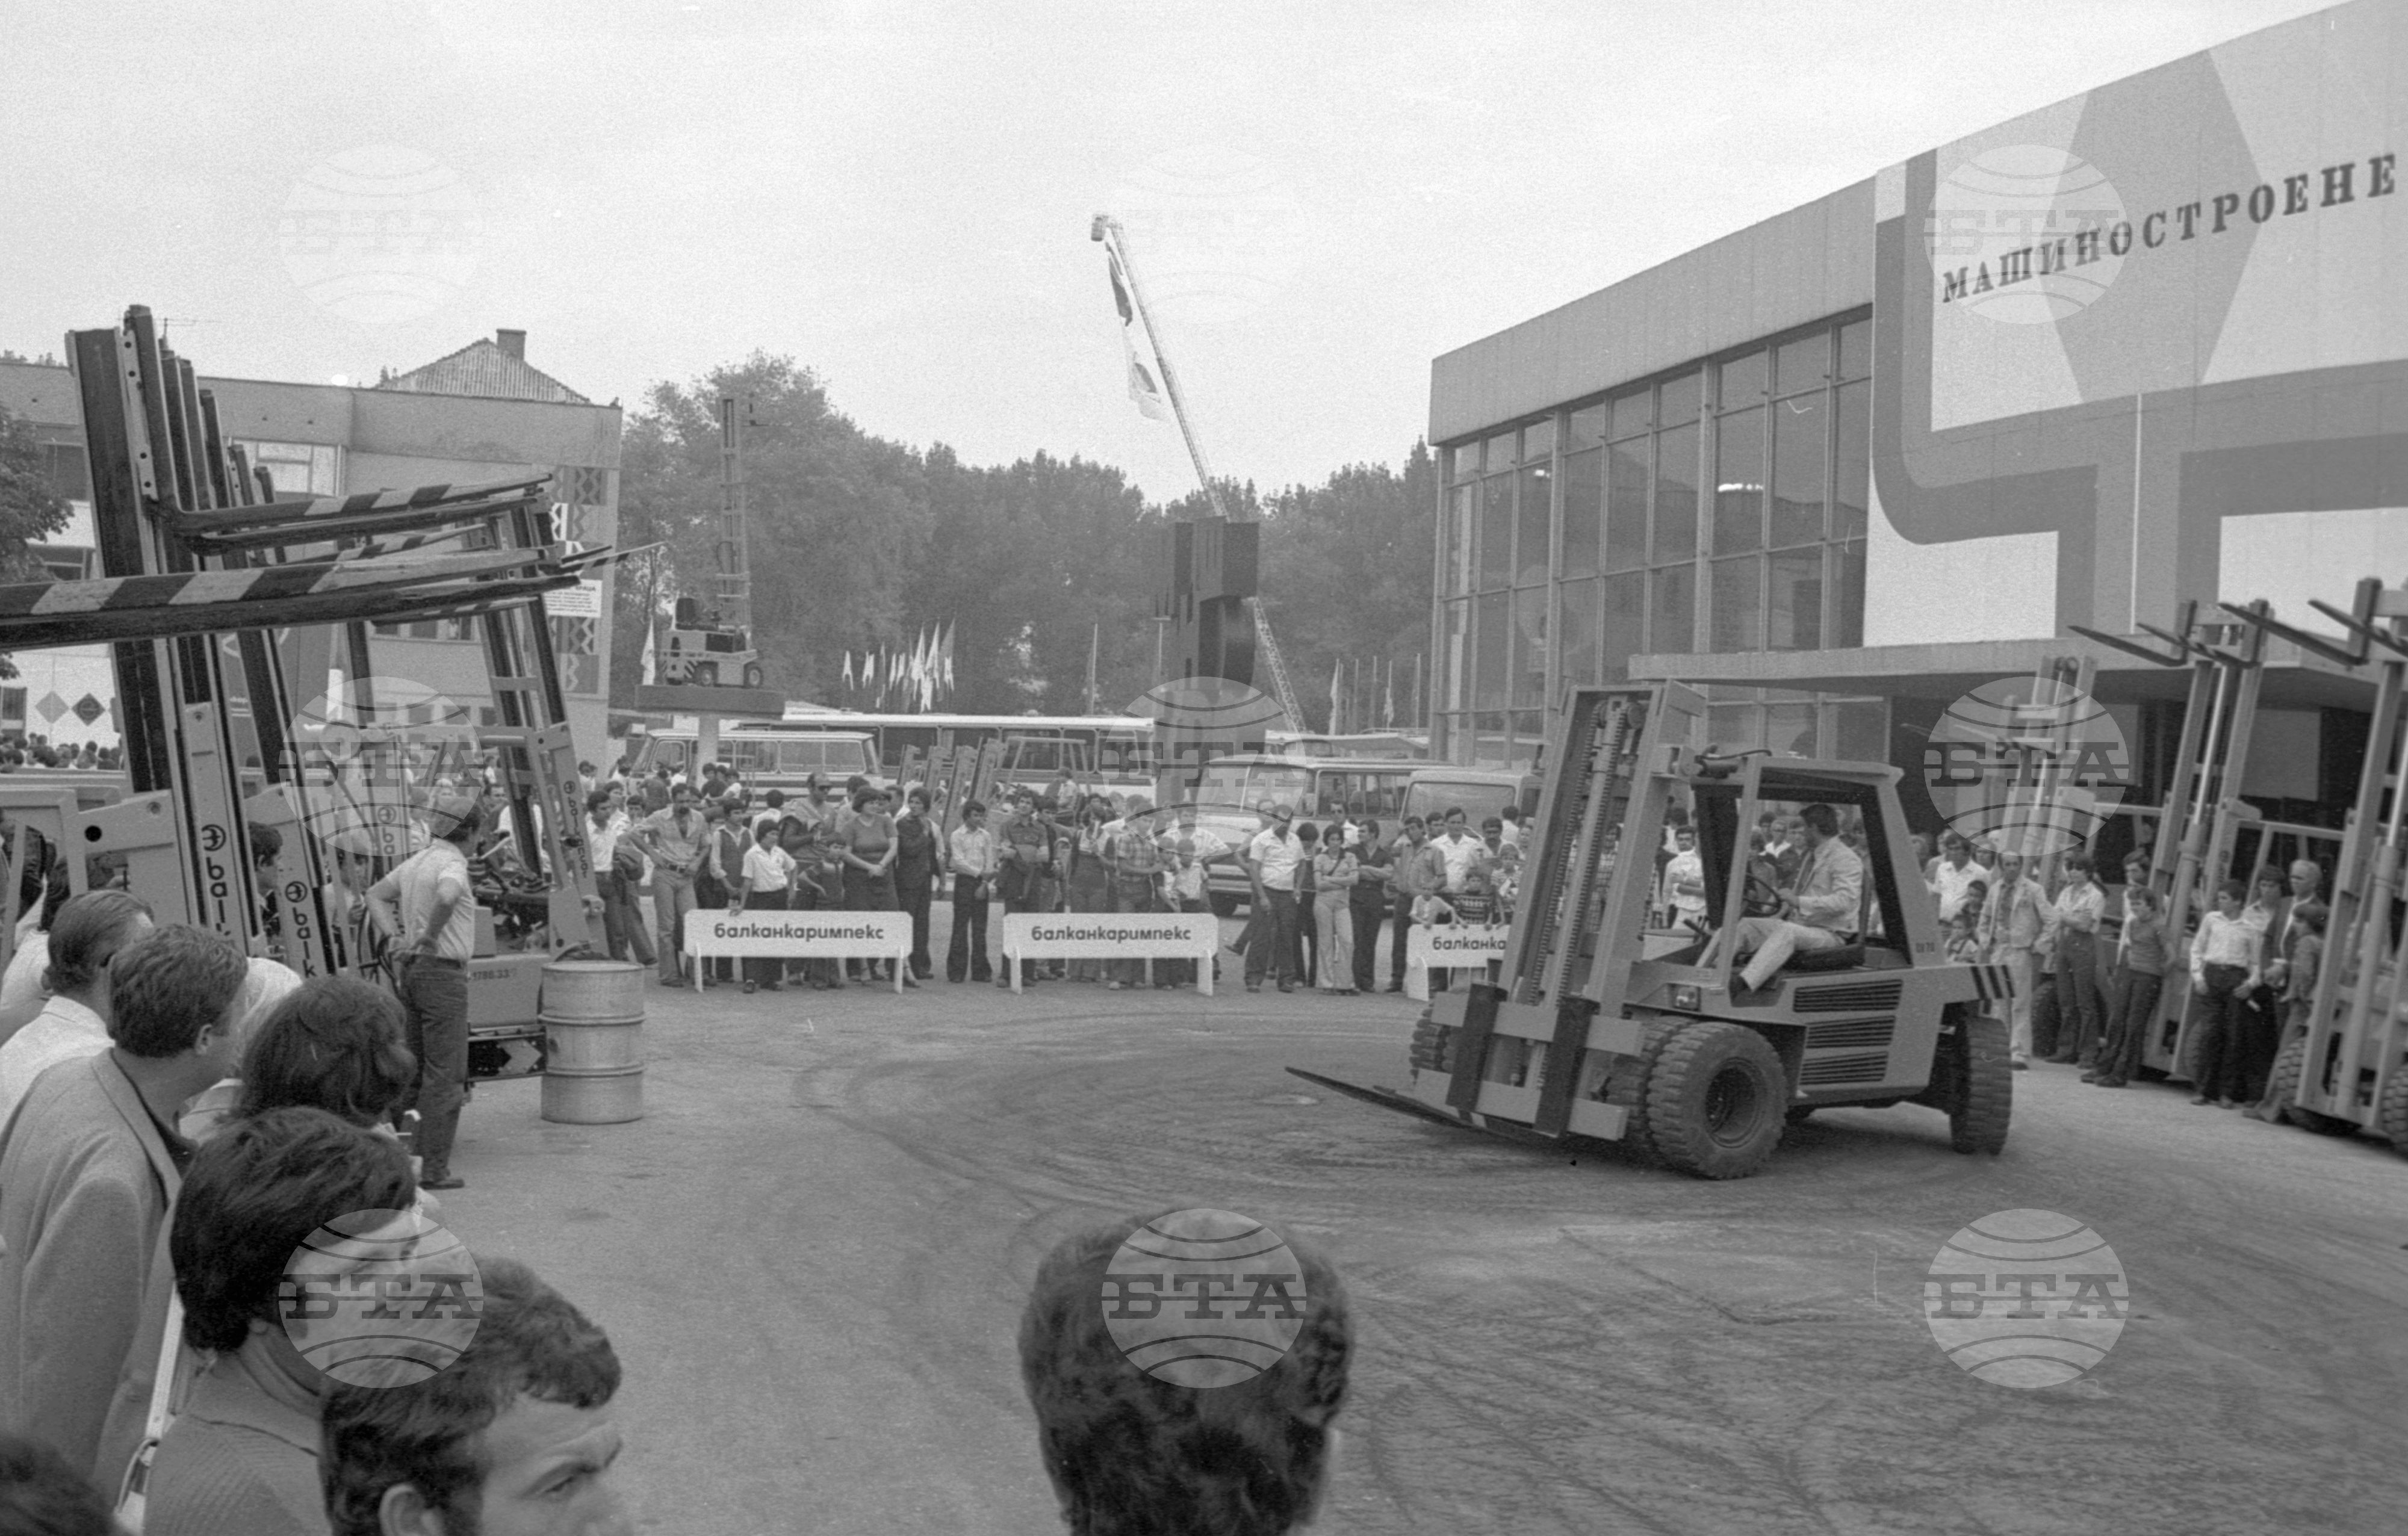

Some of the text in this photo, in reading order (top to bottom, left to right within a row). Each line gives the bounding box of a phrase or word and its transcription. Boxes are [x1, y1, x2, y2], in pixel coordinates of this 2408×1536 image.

[1942, 153, 2396, 303] МАШИНОСТРОЕНЕ
[714, 923, 884, 942] балканкаримпекс
[1031, 926, 1191, 944] балканкаримпекс
